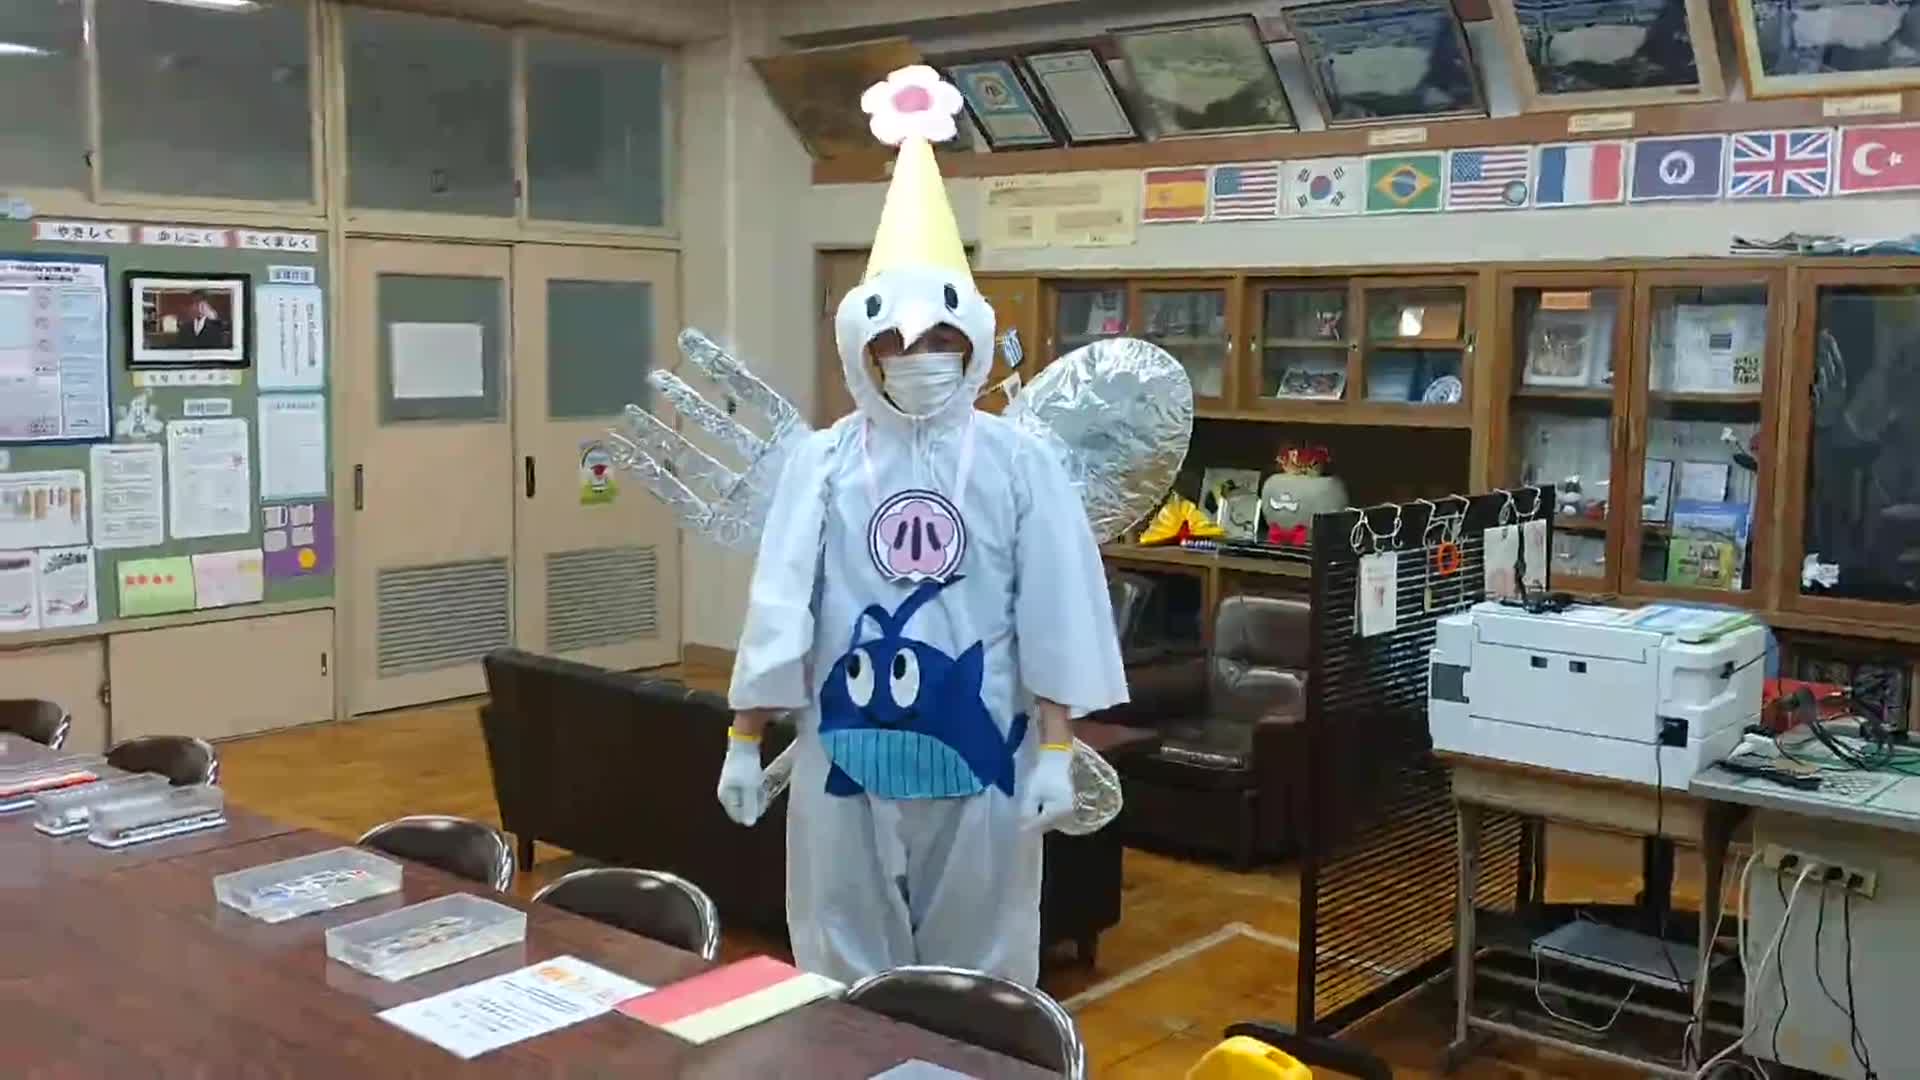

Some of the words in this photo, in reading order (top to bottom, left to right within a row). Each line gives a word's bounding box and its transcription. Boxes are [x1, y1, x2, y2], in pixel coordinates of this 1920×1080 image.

[57, 225, 113, 240] やさしく
[158, 231, 213, 244] かしこく
